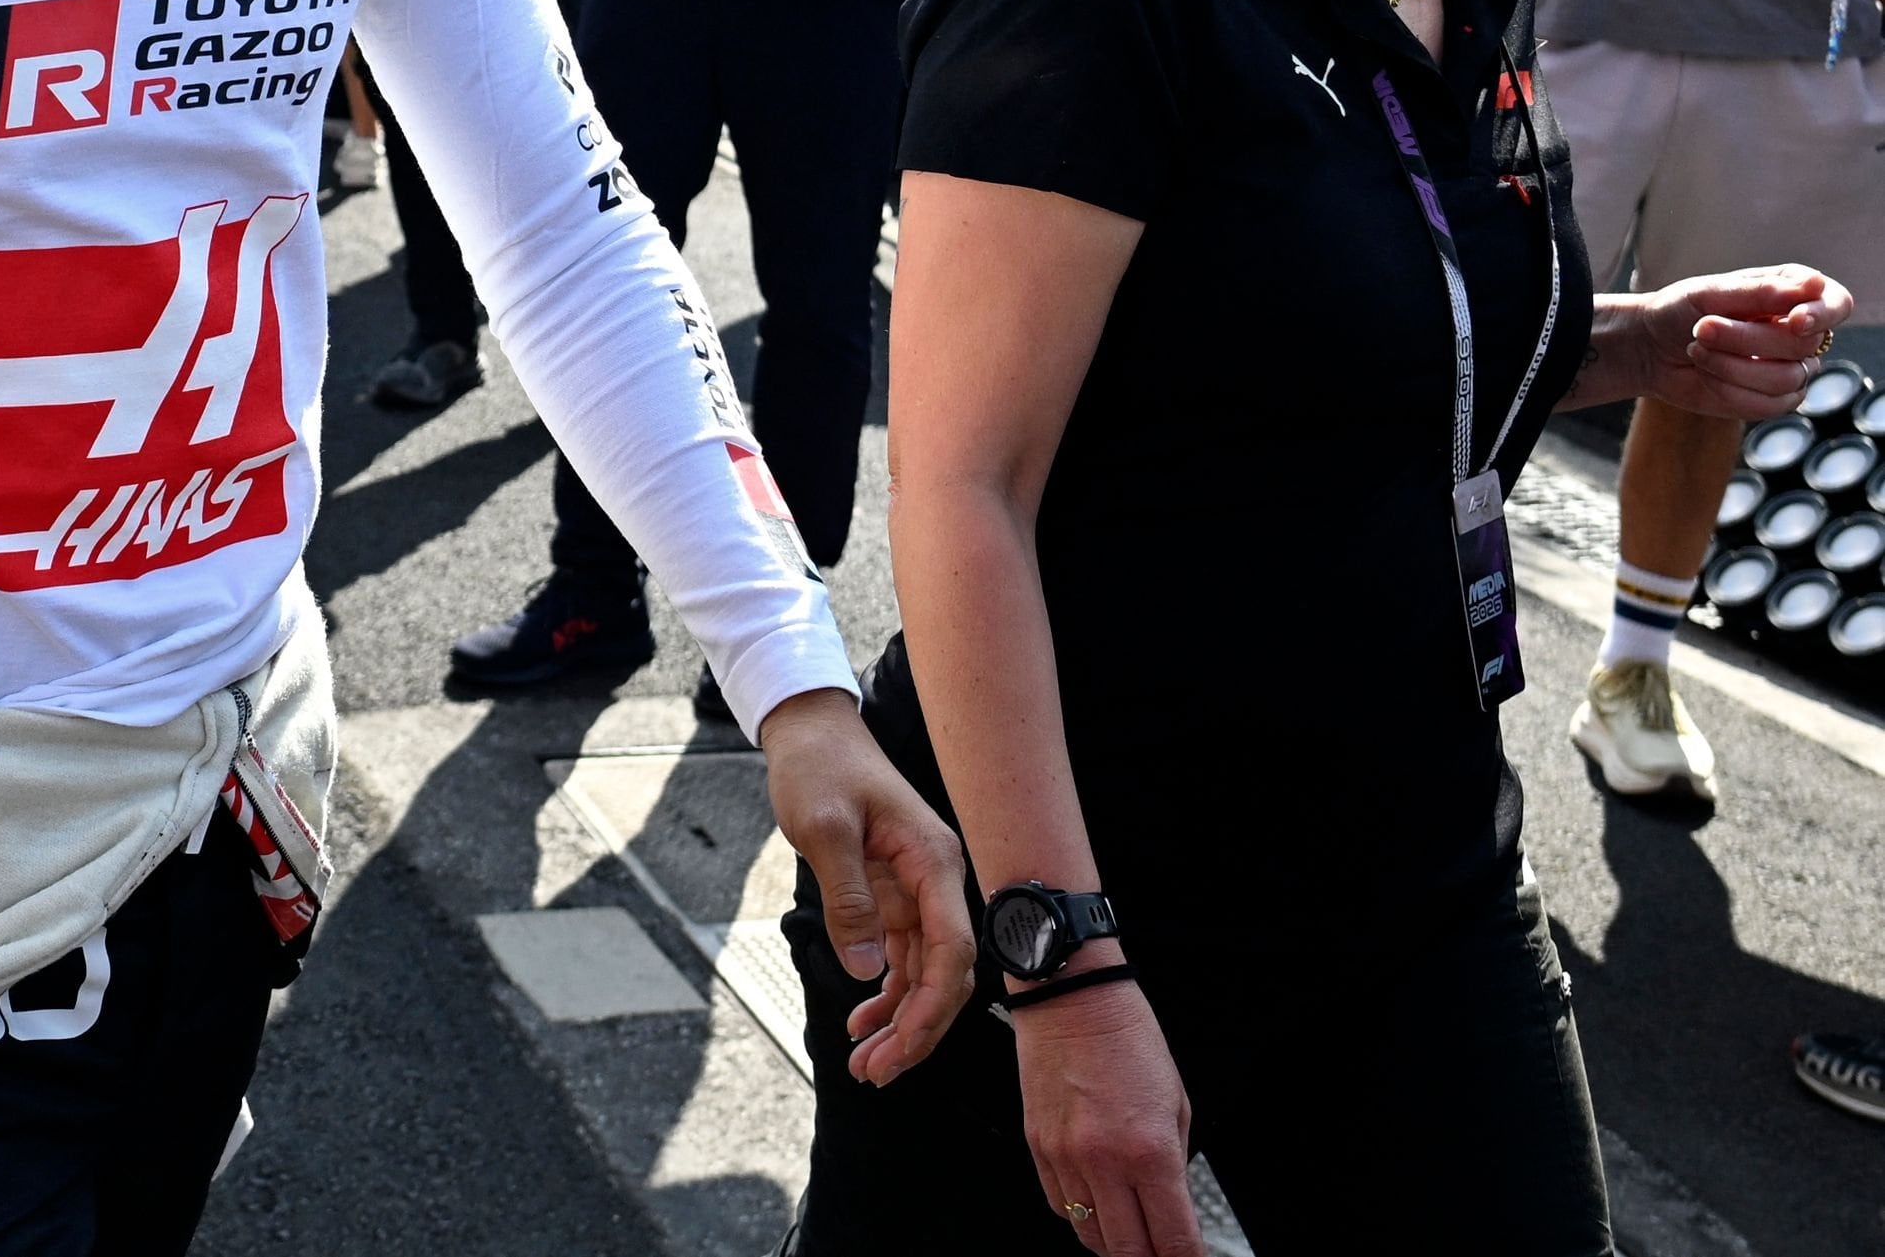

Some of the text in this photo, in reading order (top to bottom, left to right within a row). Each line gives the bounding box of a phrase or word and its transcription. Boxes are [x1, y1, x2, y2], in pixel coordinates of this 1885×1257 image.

[134, 21, 334, 71] GAZOO
[129, 65, 323, 116] Racing
[1372, 69, 1419, 156] MEDIA
[1456, 336, 1472, 415] 2026
[1468, 571, 1506, 605] MEDIA
[1469, 594, 1503, 628] 2026
